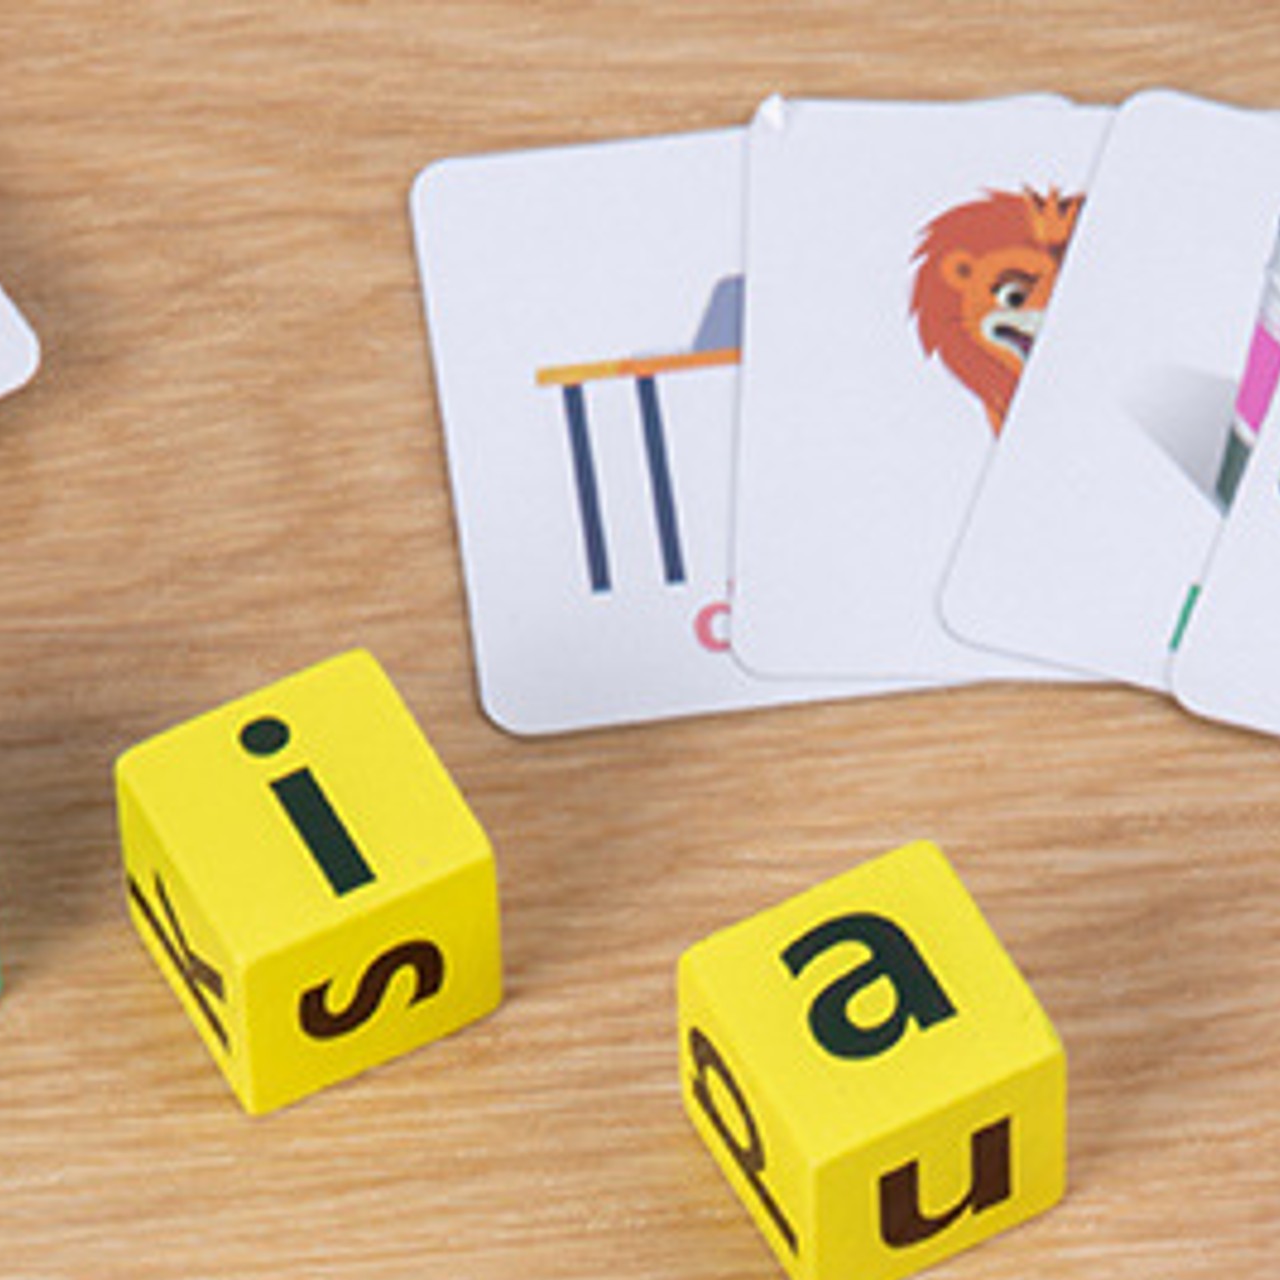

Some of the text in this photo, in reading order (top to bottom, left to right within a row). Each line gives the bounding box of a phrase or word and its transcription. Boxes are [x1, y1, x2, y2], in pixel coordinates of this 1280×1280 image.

[238, 716, 377, 897] i
[779, 911, 957, 1059] a
[877, 1115, 1012, 1249] u
